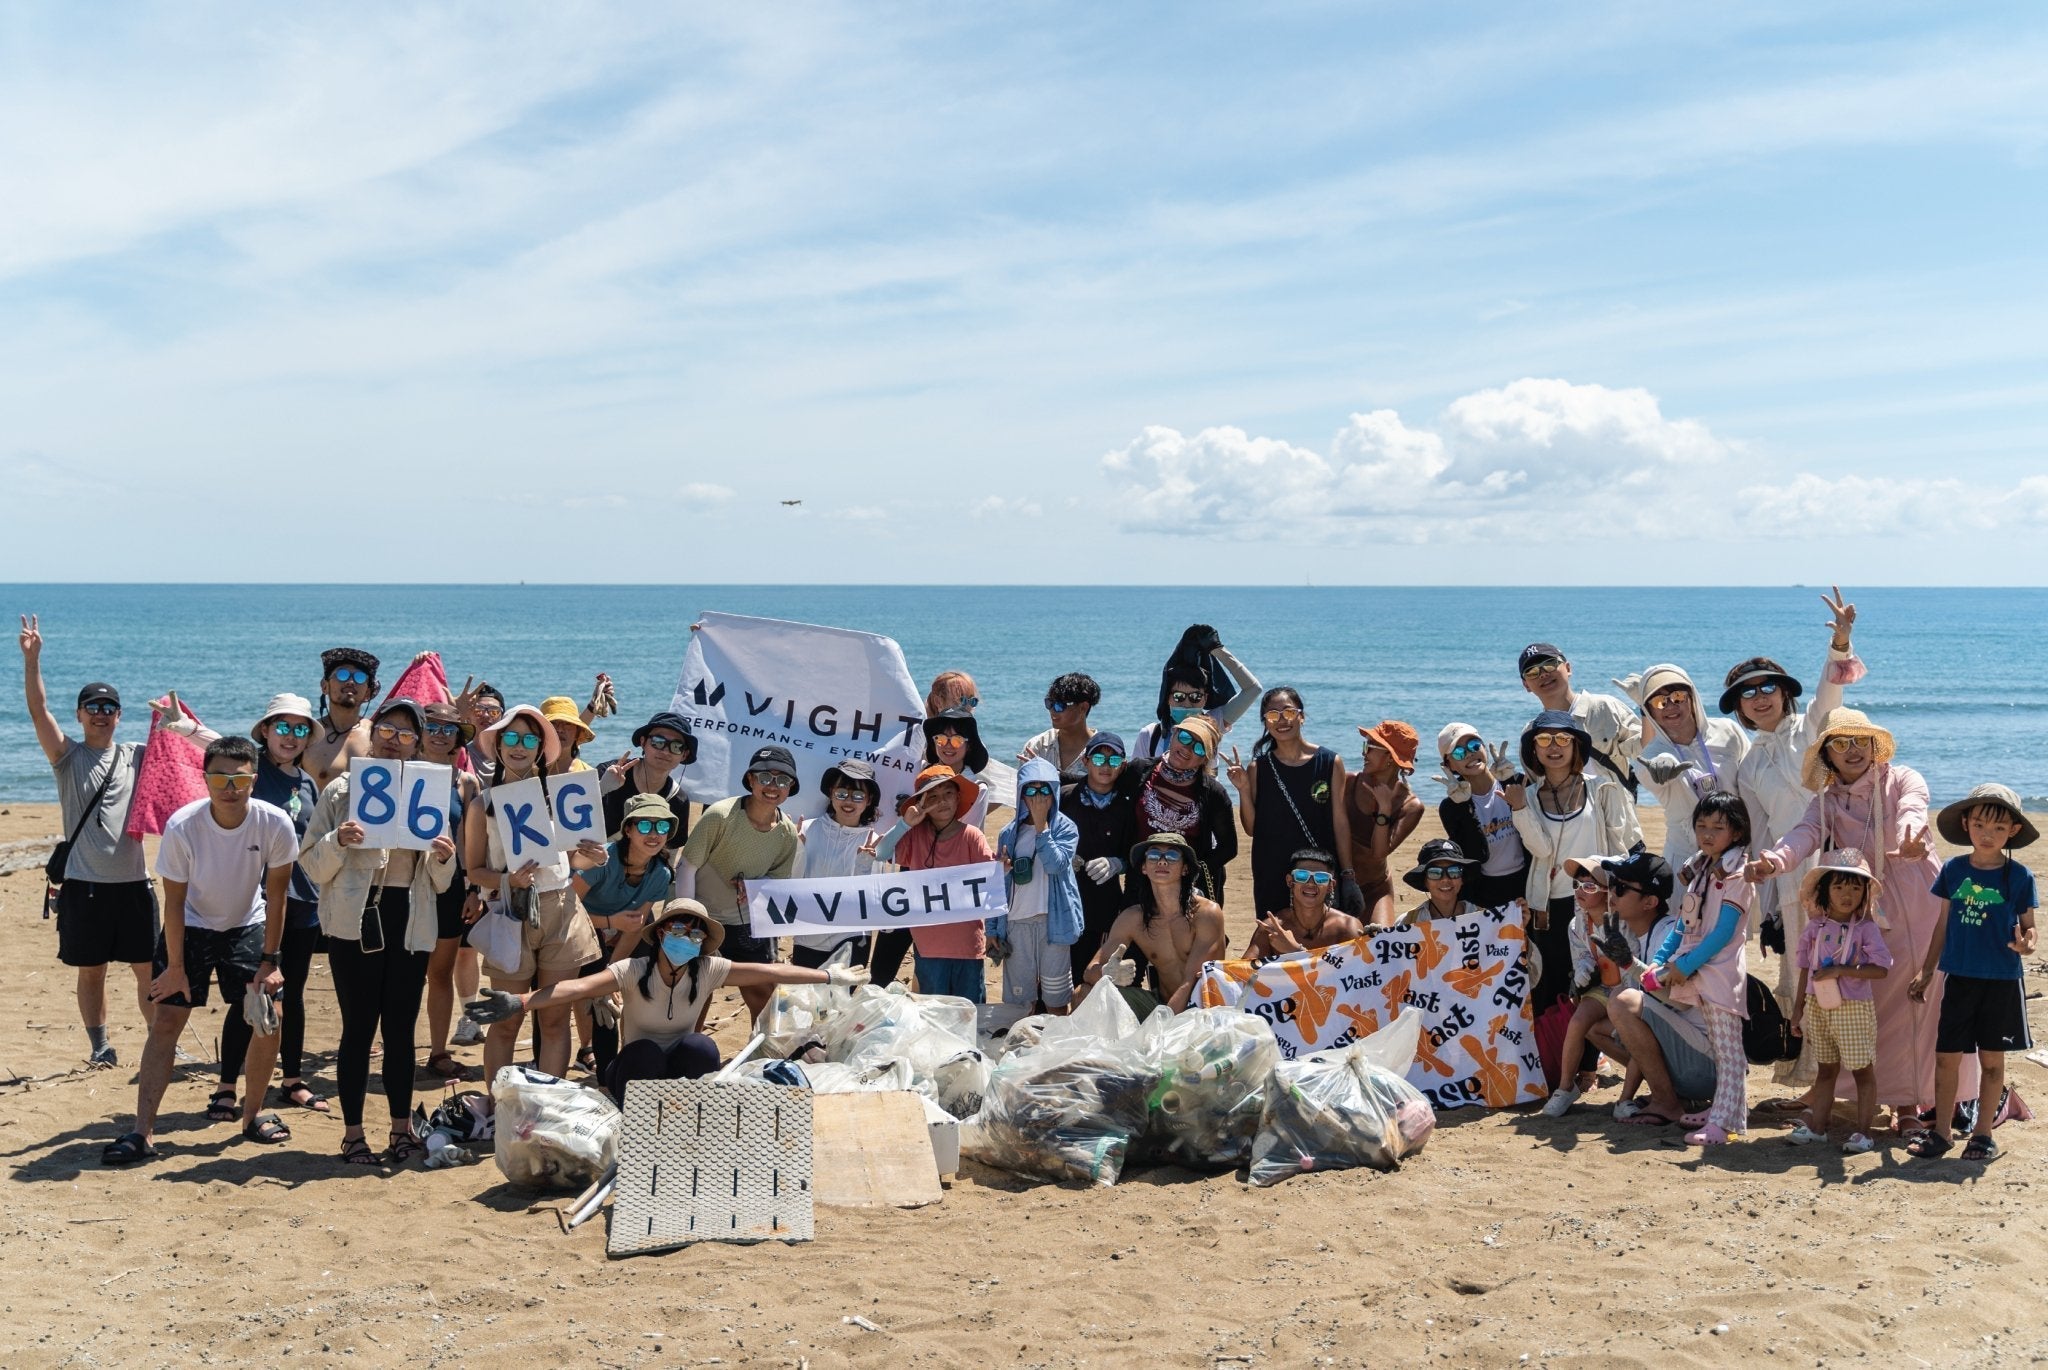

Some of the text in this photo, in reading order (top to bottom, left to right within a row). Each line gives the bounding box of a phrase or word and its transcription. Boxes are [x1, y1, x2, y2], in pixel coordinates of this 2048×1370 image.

[744, 690, 923, 747] VIGHT
[829, 746, 915, 773] EYEWEAR
[357, 765, 593, 855] 86 KG
[813, 876, 987, 922] VIGHT
[1966, 905, 1980, 917] for
[1960, 914, 1982, 926] love
[1485, 944, 1509, 957] Vast
[1340, 970, 1383, 993] Vast
[1275, 1033, 1298, 1061] Vas
